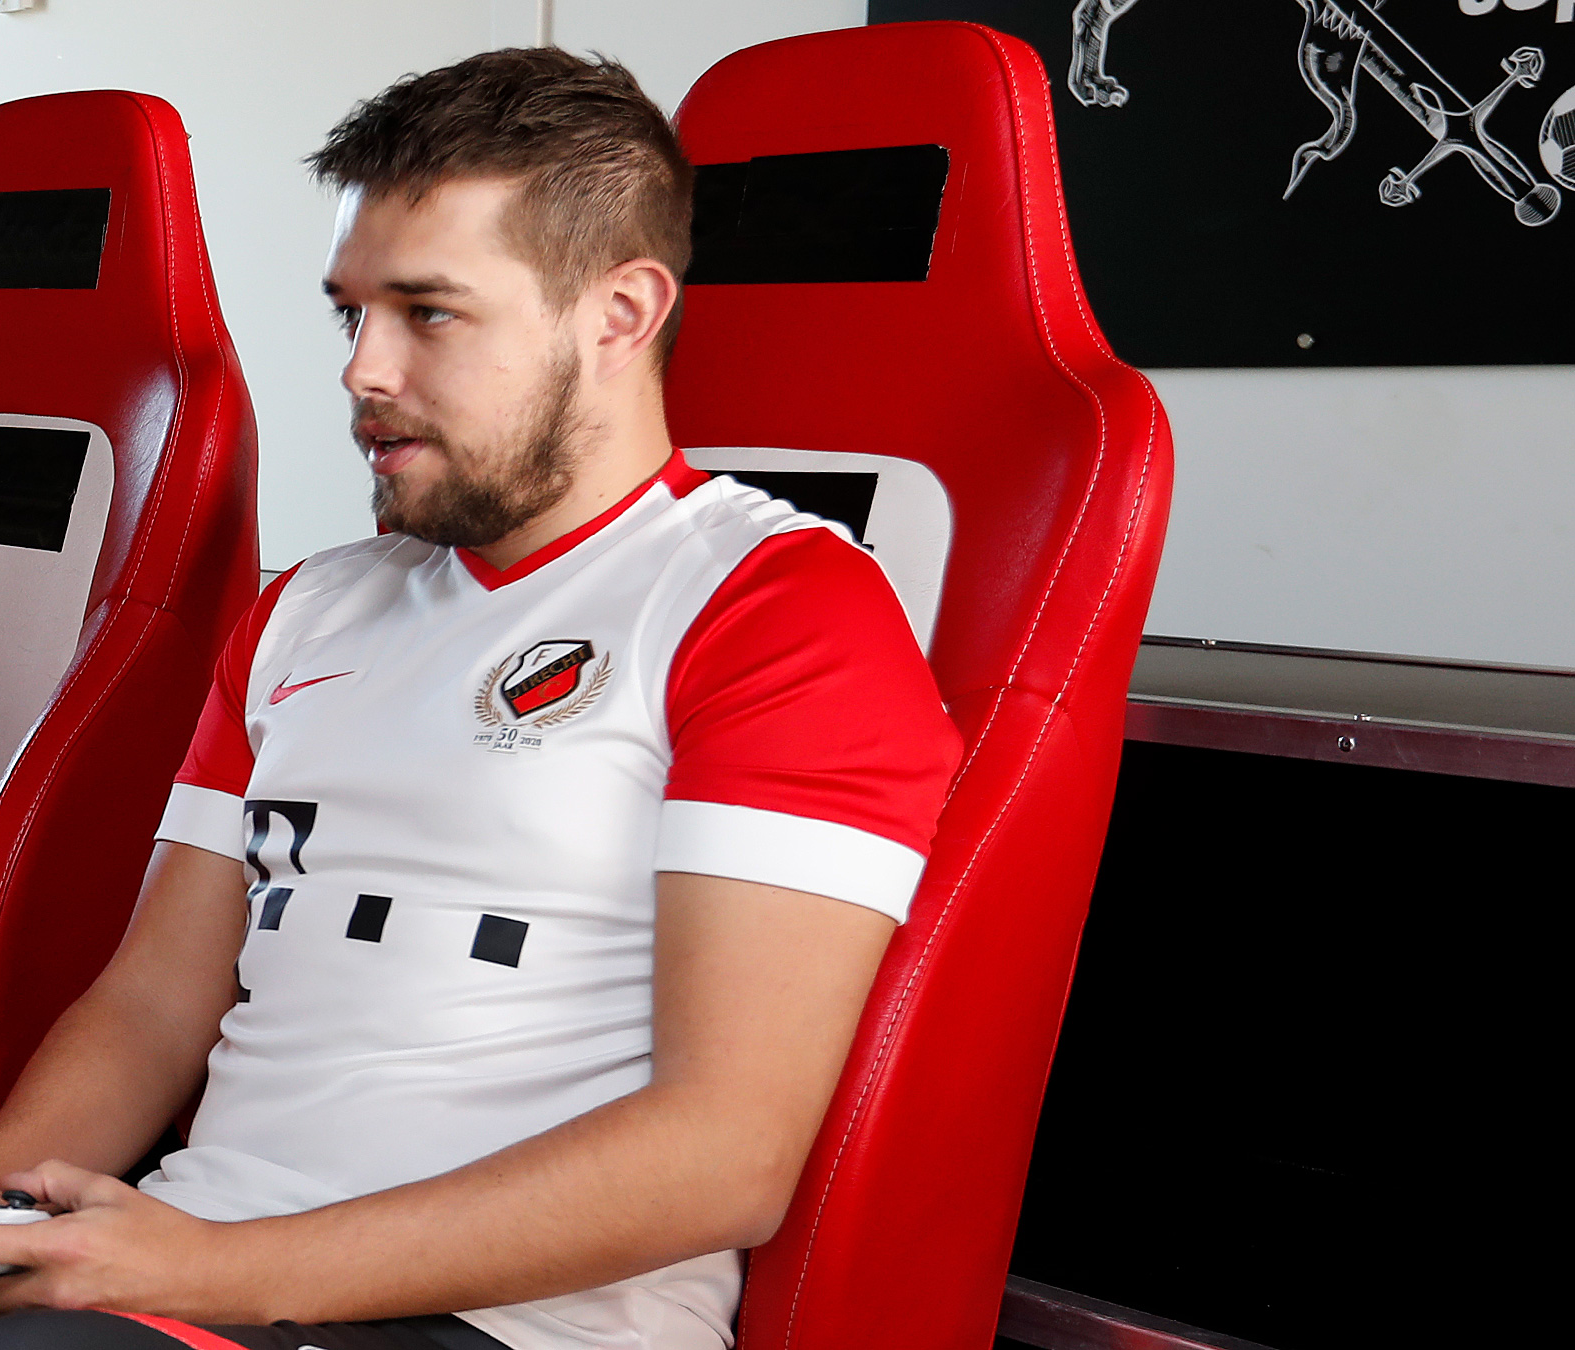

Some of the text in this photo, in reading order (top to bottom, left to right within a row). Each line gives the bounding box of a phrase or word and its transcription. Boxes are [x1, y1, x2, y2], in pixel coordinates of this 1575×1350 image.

[530, 648, 552, 667] F
[507, 648, 588, 698] UTRECHT
[497, 727, 518, 742] 50
[520, 736, 542, 747] 2020
